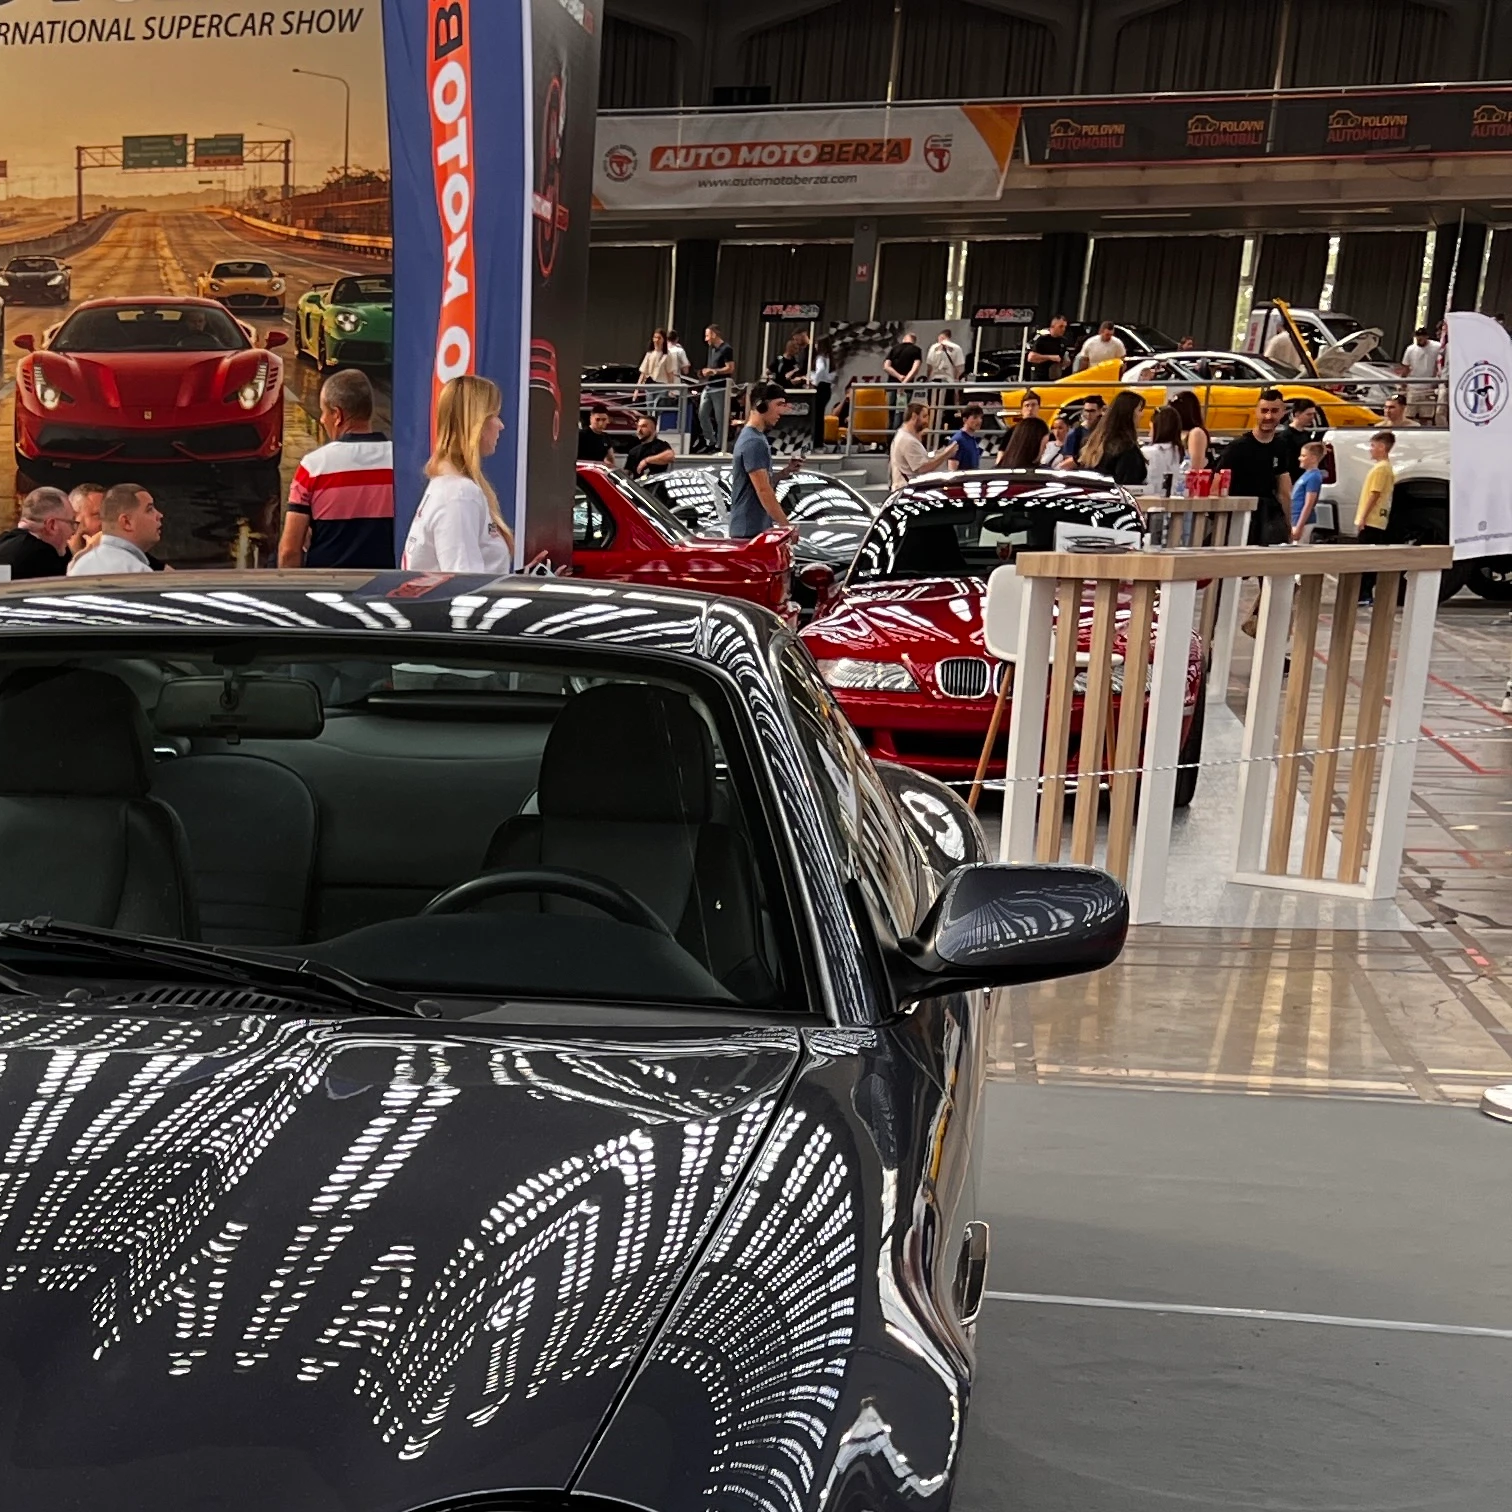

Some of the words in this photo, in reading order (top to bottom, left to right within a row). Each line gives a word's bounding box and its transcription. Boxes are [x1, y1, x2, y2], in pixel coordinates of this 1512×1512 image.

[141, 10, 275, 41] SUPERCAR
[278, 7, 364, 35] SHOW
[1219, 120, 1264, 132] POLOVNI
[1362, 114, 1408, 127] POLOVNI
[1082, 124, 1125, 136] POLOVNI
[1327, 126, 1406, 143] AUTOMOBILI
[1049, 135, 1123, 151] AUTOMOBILI
[1186, 132, 1262, 147] AUTOMOBILI
[656, 147, 731, 169] AUTO
[697, 174, 857, 188] www.automotoberza.com
